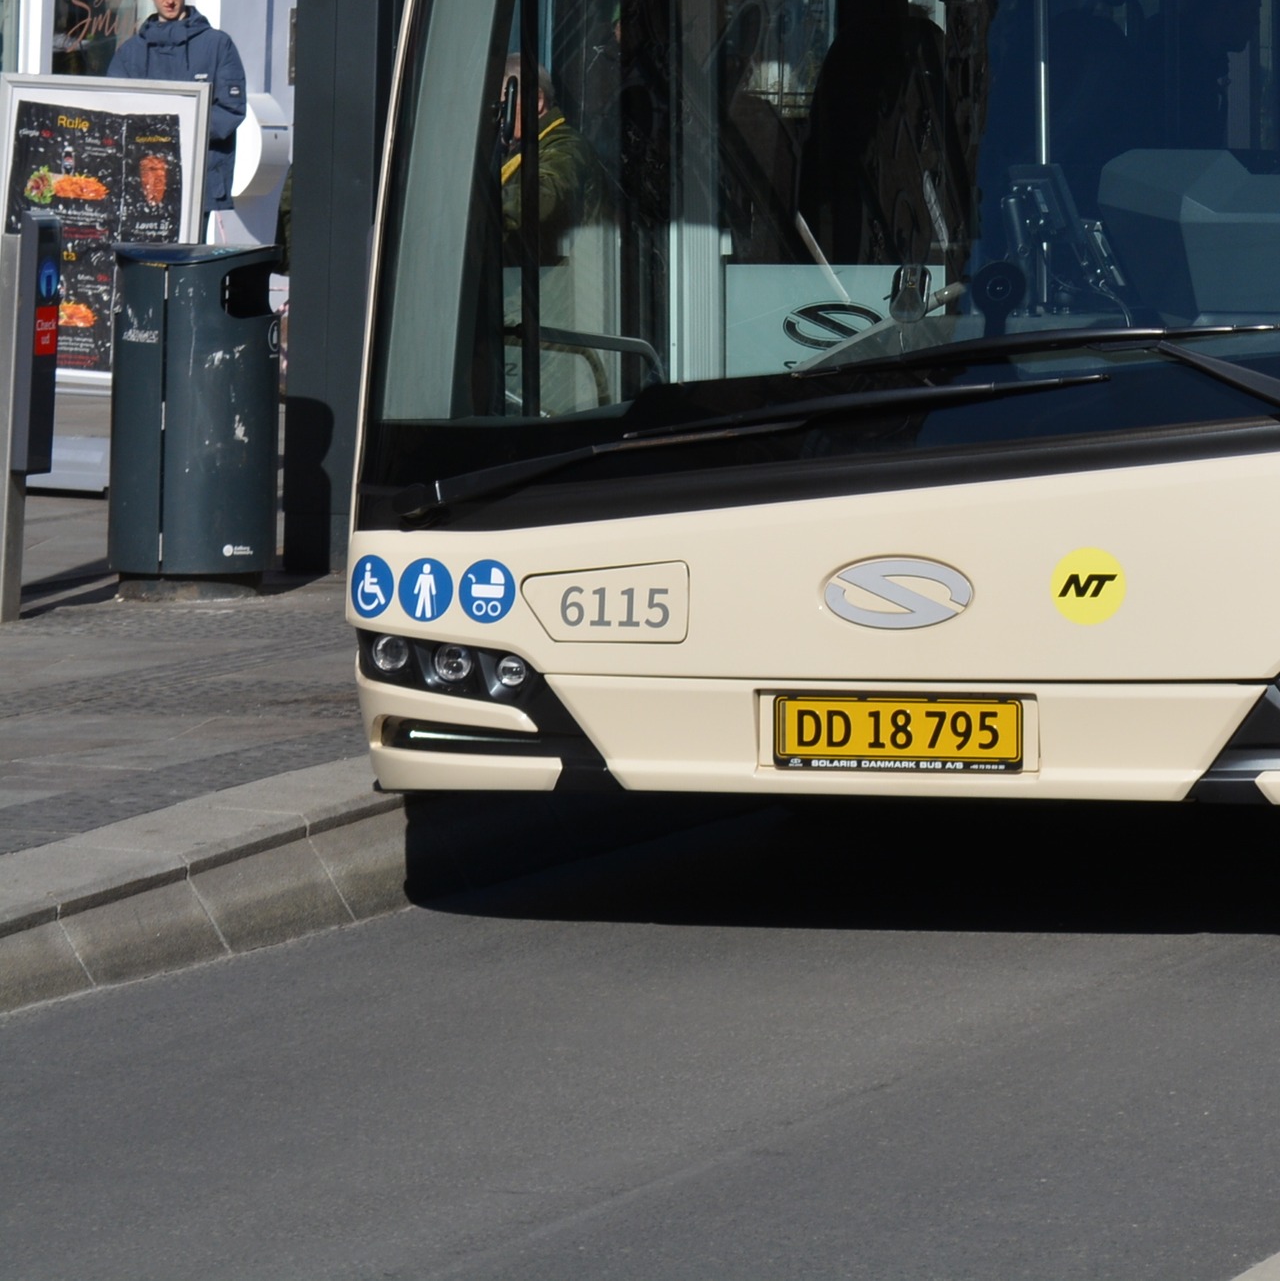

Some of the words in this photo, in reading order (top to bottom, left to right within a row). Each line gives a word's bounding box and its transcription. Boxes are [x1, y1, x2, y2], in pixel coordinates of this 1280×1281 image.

[36, 319, 57, 331] Check
[1058, 573, 1118, 598] NT
[560, 585, 670, 629] 6115
[797, 709, 851, 748] DD
[868, 709, 913, 750] 18
[925, 710, 999, 751] 795
[811, 759, 857, 769] SOLARIS
[861, 760, 916, 769] DANMARK
[920, 760, 942, 770] BUS
[946, 760, 964, 770] A/S
